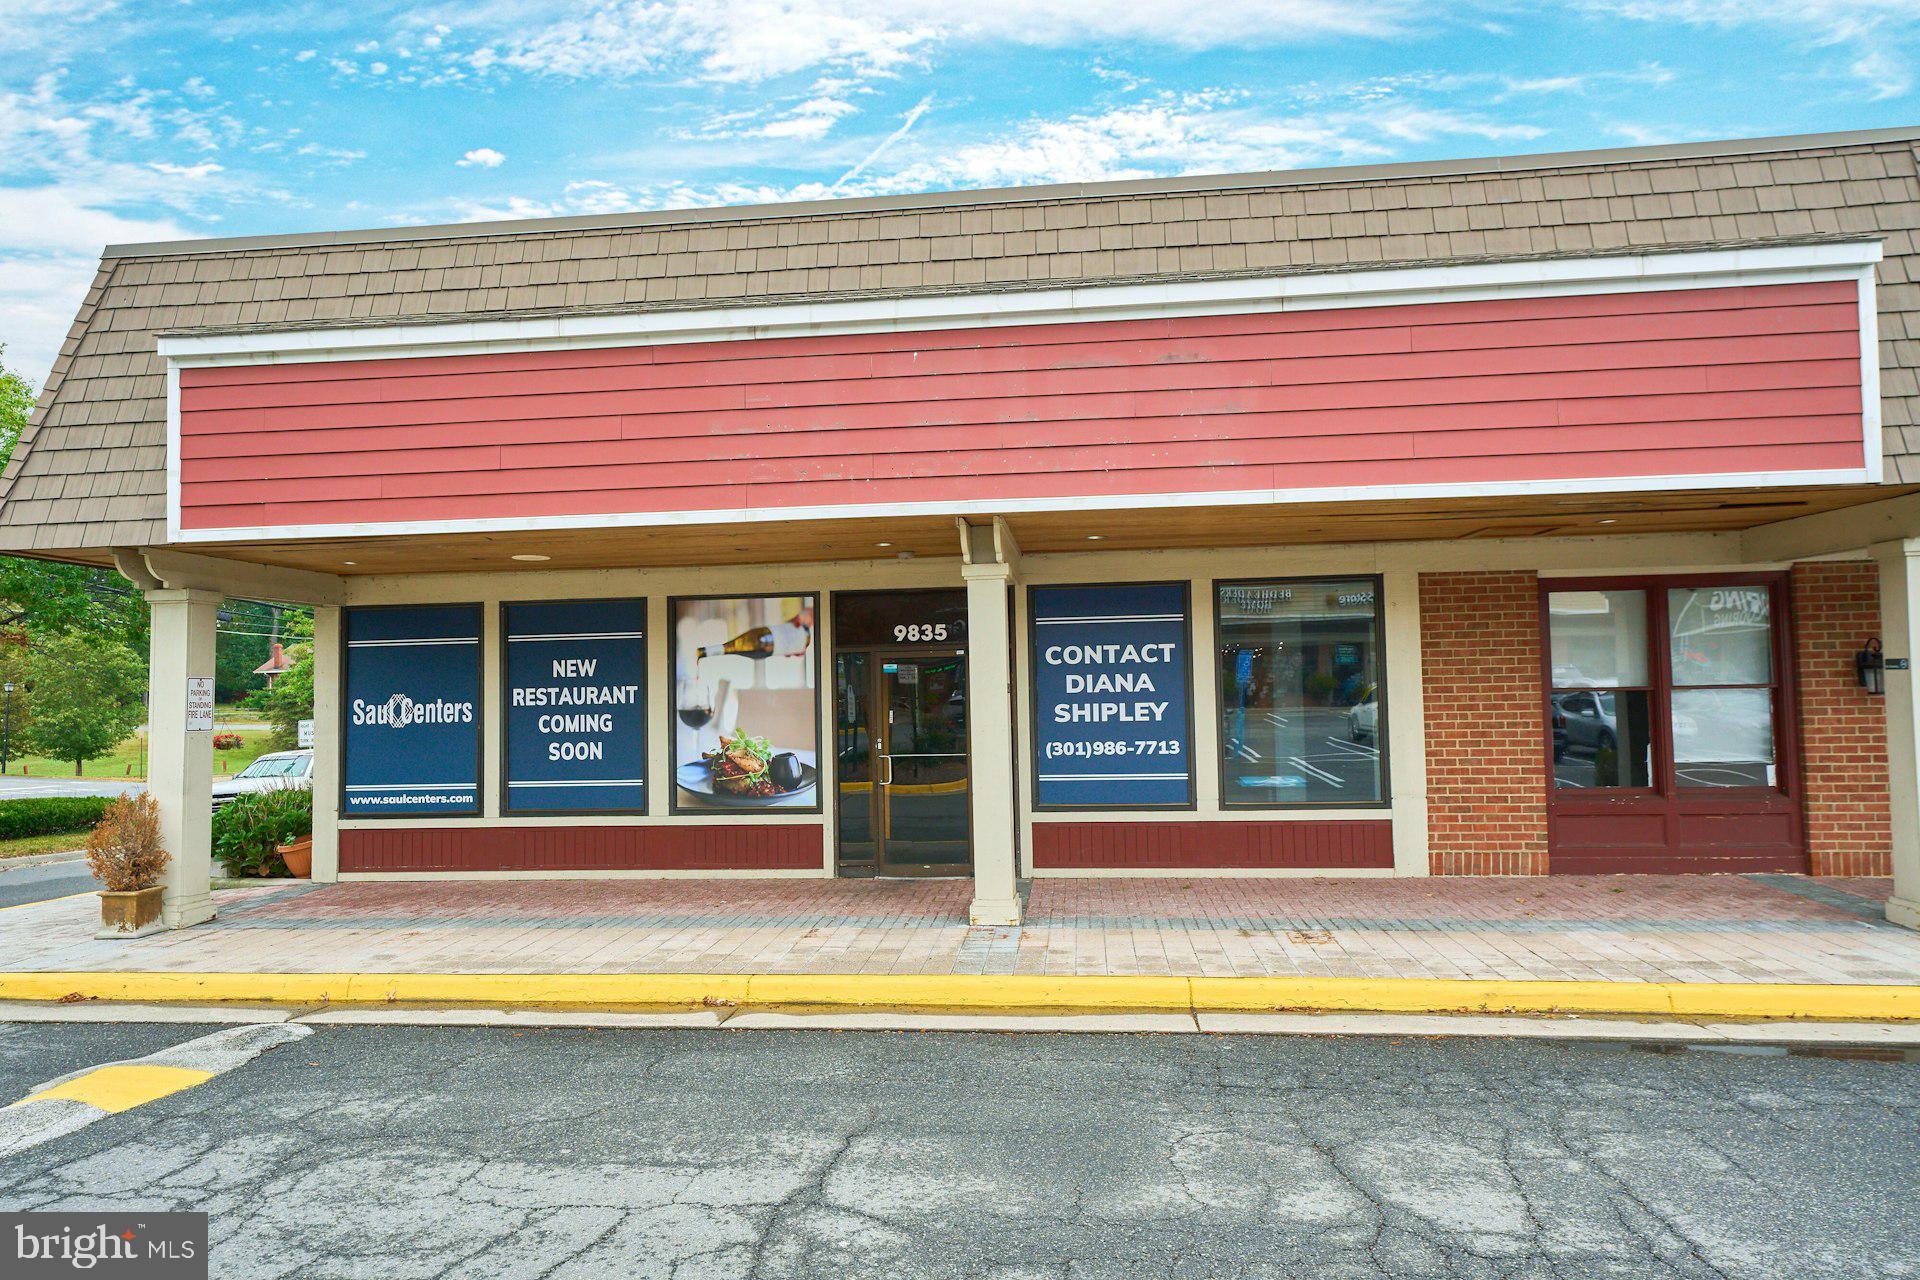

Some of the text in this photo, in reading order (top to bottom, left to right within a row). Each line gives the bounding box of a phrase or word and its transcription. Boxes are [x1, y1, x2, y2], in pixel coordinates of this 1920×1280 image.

[893, 623, 947, 642] 9835
[1045, 643, 1175, 665] CONTACT
[552, 658, 597, 677] NEW
[1065, 673, 1156, 694] DIANA
[512, 686, 638, 706] RESTAURANT
[188, 710, 212, 719] FIRE LANE
[1054, 701, 1170, 723] SHIPLEY
[538, 713, 613, 734] COMING
[548, 741, 603, 761] SOON
[1045, 740, 1181, 759] (301)986-7713
[350, 794, 474, 805] www.saulcenters.com
